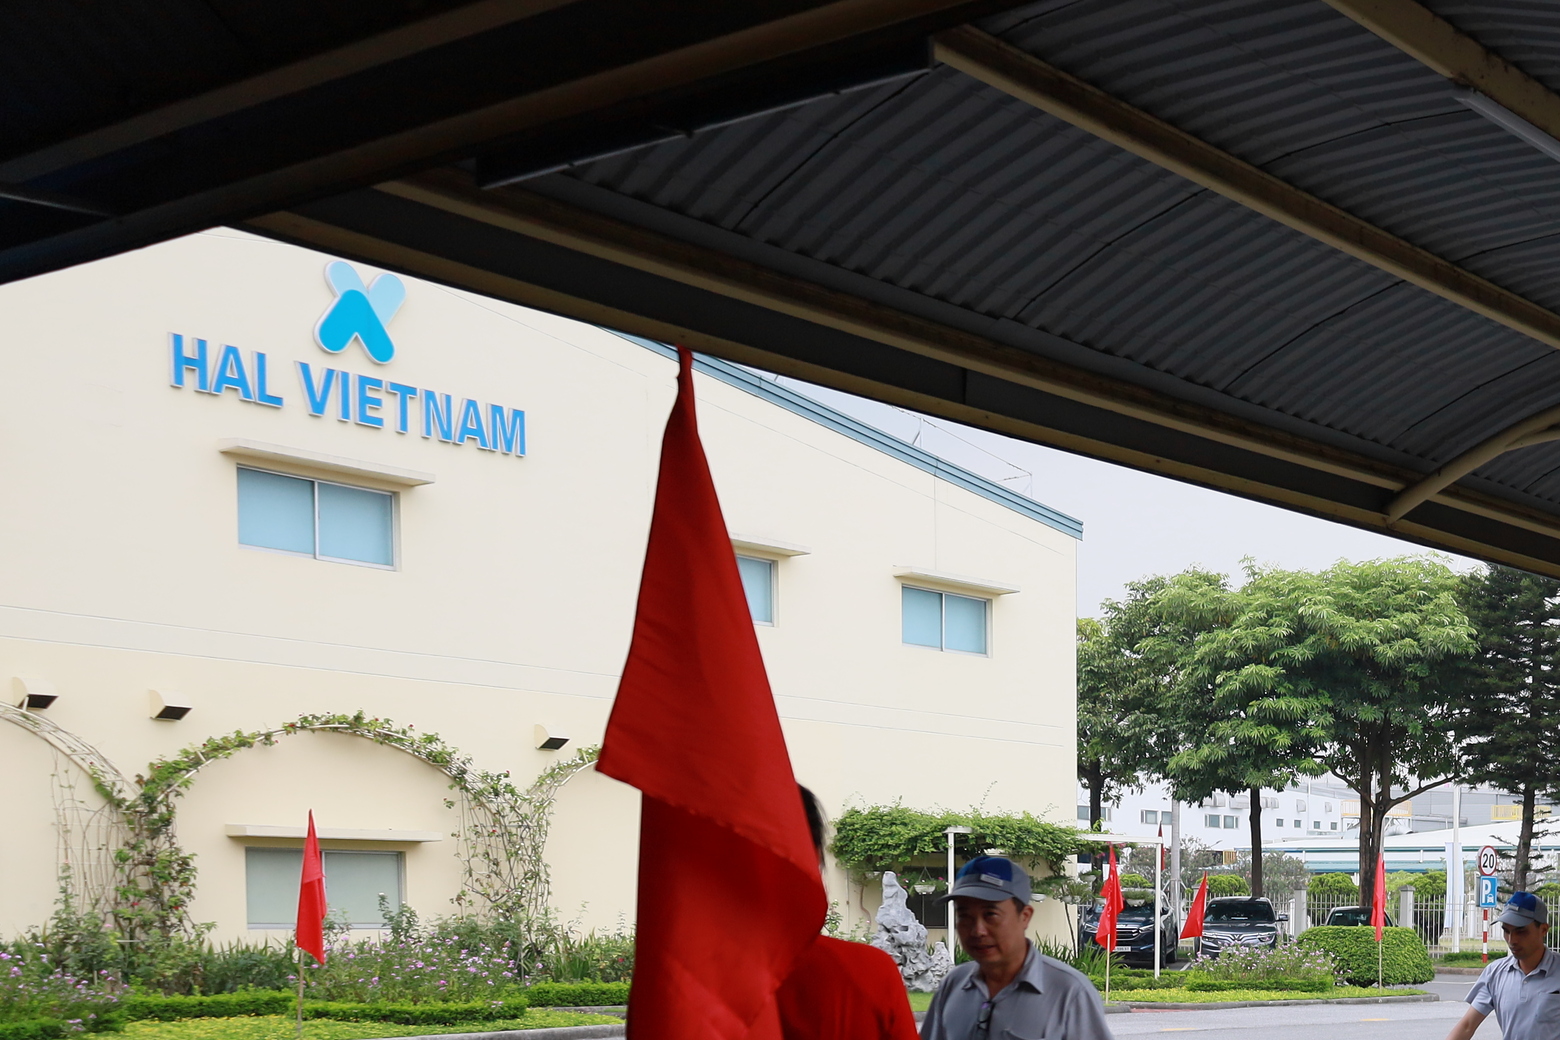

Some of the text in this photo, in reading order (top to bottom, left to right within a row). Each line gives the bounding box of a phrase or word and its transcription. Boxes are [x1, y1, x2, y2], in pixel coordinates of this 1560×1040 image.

[169, 331, 527, 458] HAL VIETNAM
[1483, 853, 1494, 868] 20
[1482, 879, 1492, 903] P
